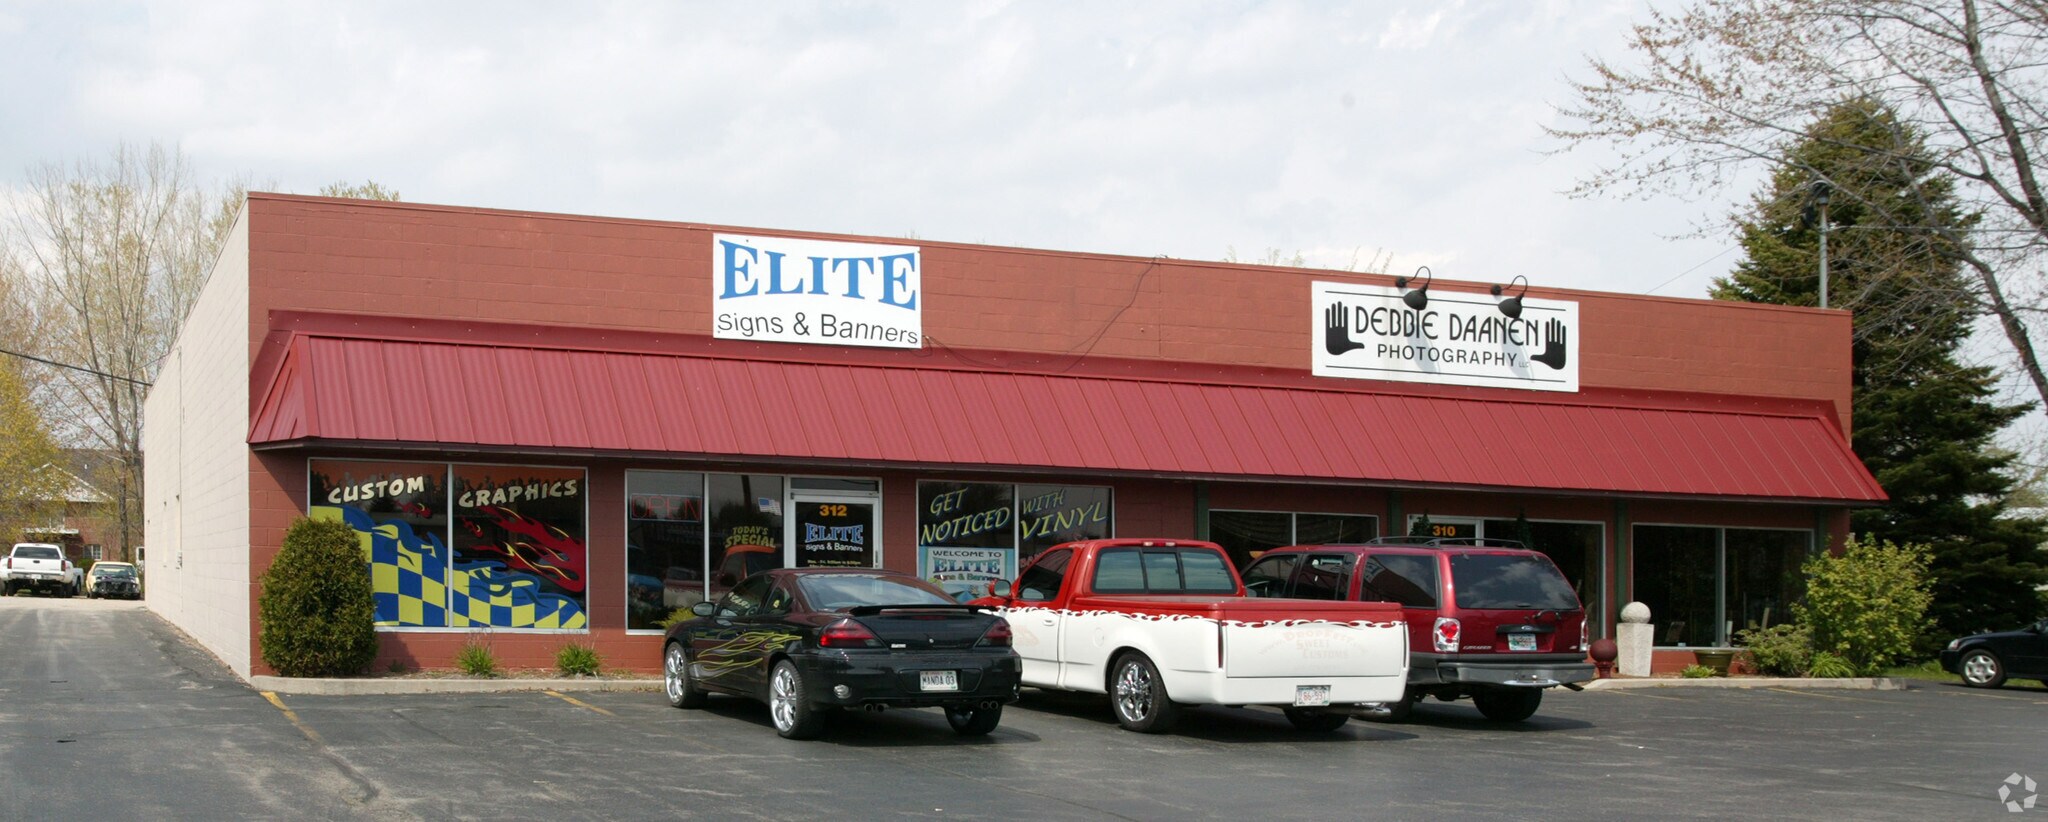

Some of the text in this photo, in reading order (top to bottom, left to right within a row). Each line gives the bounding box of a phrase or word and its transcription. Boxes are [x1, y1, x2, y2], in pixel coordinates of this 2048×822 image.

[719, 239, 916, 311] ELITE
[718, 312, 918, 344] Signs & Banners
[1355, 305, 1539, 346] DEBBIE DAANEN
[1377, 343, 1518, 367] PHOTOGRAPHY
[327, 475, 426, 504] CUSTOM
[458, 479, 578, 509] GRAPHICS
[930, 487, 969, 516] GET
[1022, 489, 1065, 515] WITH
[632, 495, 702, 520] OPEN
[819, 505, 847, 516] 312
[732, 526, 768, 535] TODAY'S
[805, 522, 863, 545] ELITE
[921, 506, 1011, 545] NOTICED
[1020, 502, 1107, 540] VINYL
[1432, 525, 1456, 537] 310
[725, 534, 776, 548] SPECIAL
[827, 542, 833, 550] &
[834, 542, 863, 552] Banners
[932, 550, 984, 558] WELCOME
[932, 557, 1000, 575] ELITE
